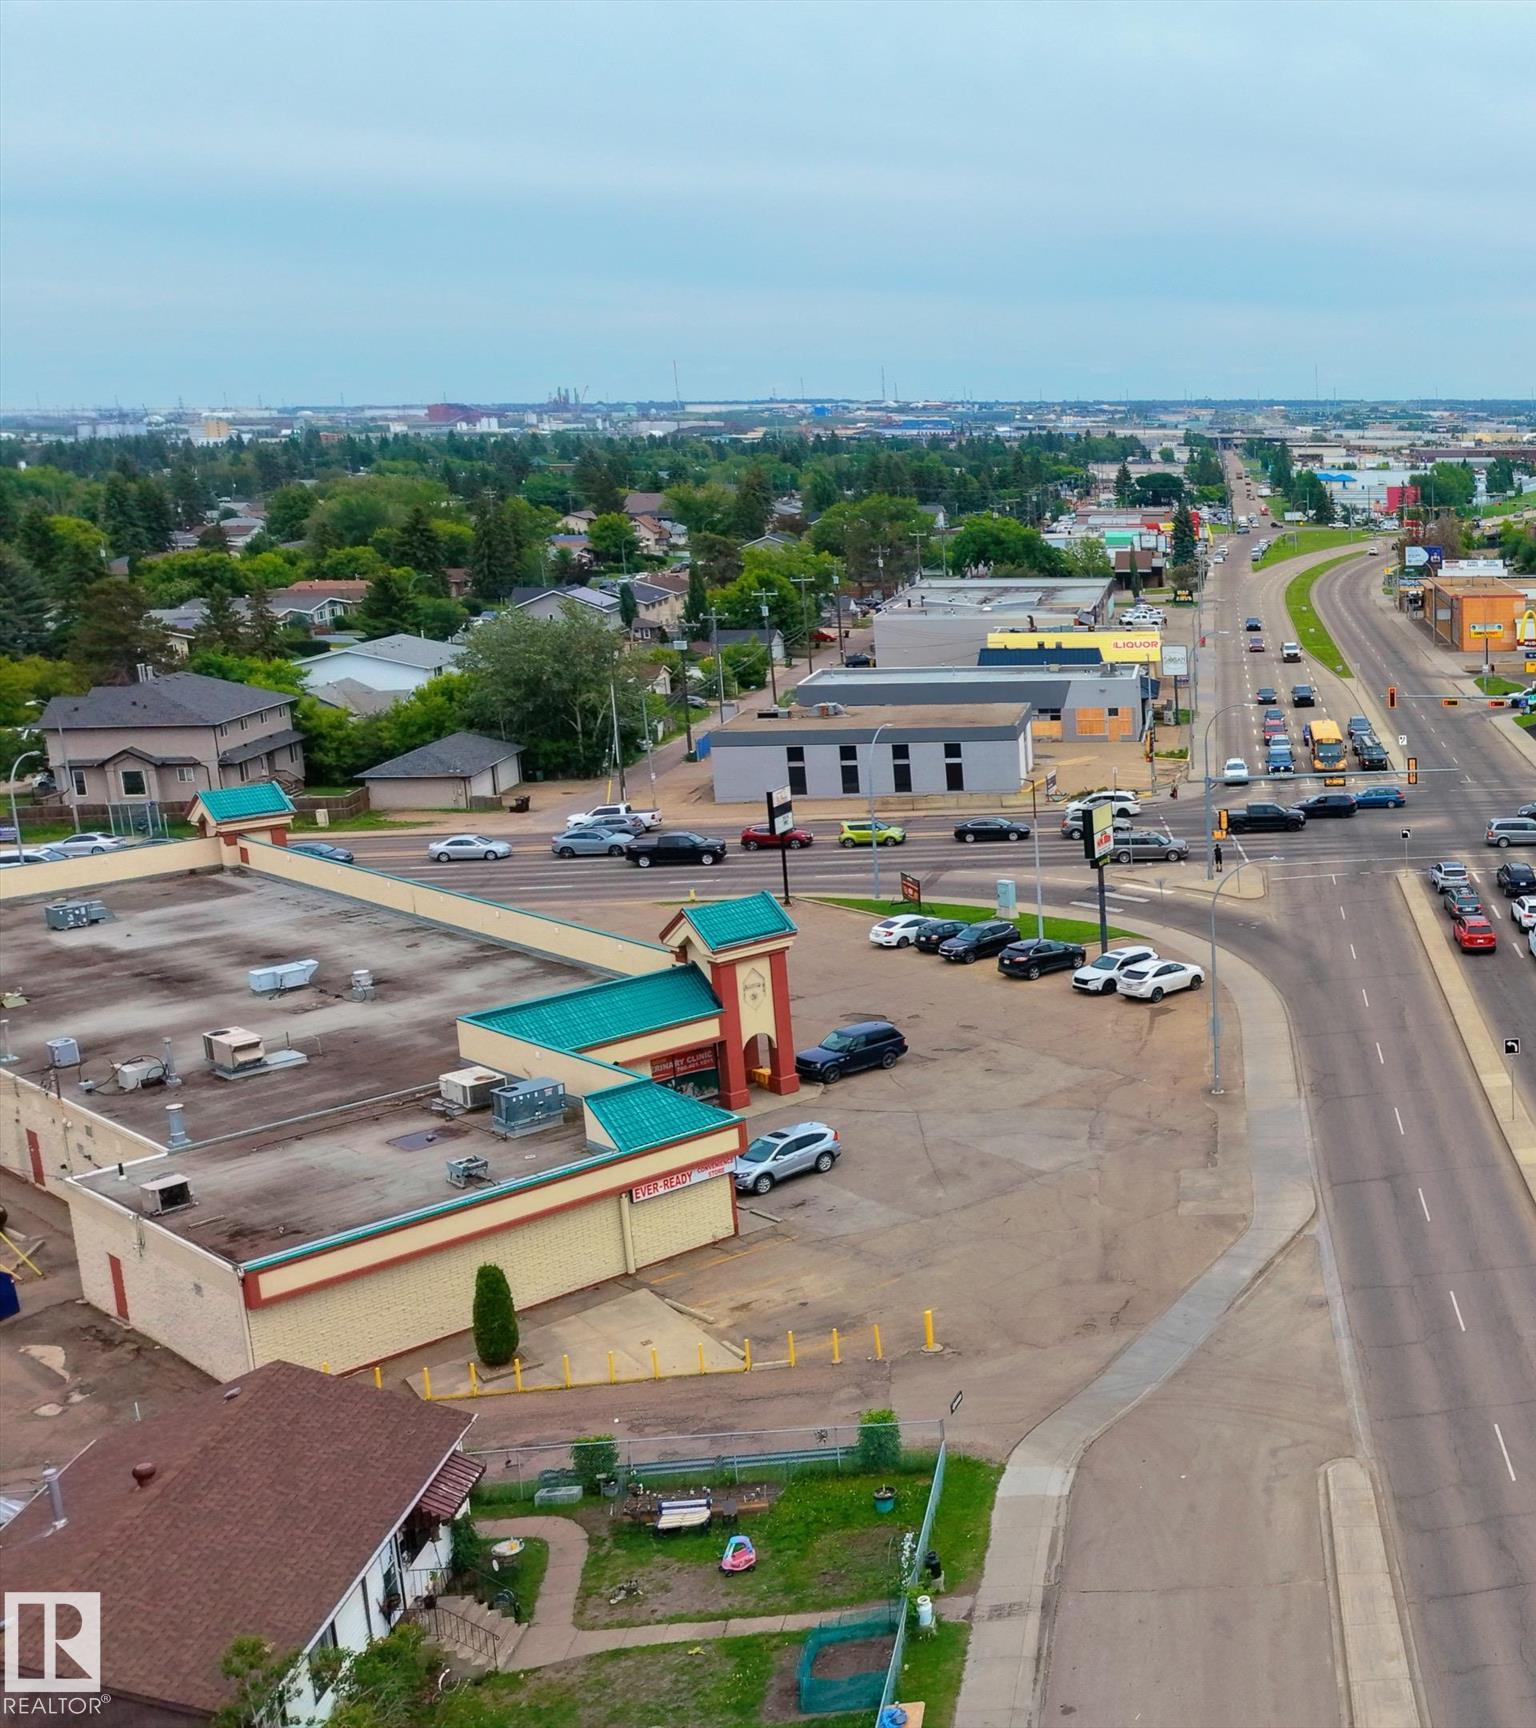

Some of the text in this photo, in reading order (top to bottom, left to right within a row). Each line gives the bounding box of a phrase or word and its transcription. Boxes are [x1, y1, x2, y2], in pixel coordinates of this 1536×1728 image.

[1115, 640, 1159, 649] LIQUOR
[686, 1049, 713, 1064] CLINIC
[708, 1167, 725, 1178] STORE
[634, 1171, 693, 1200] EVER-READY
